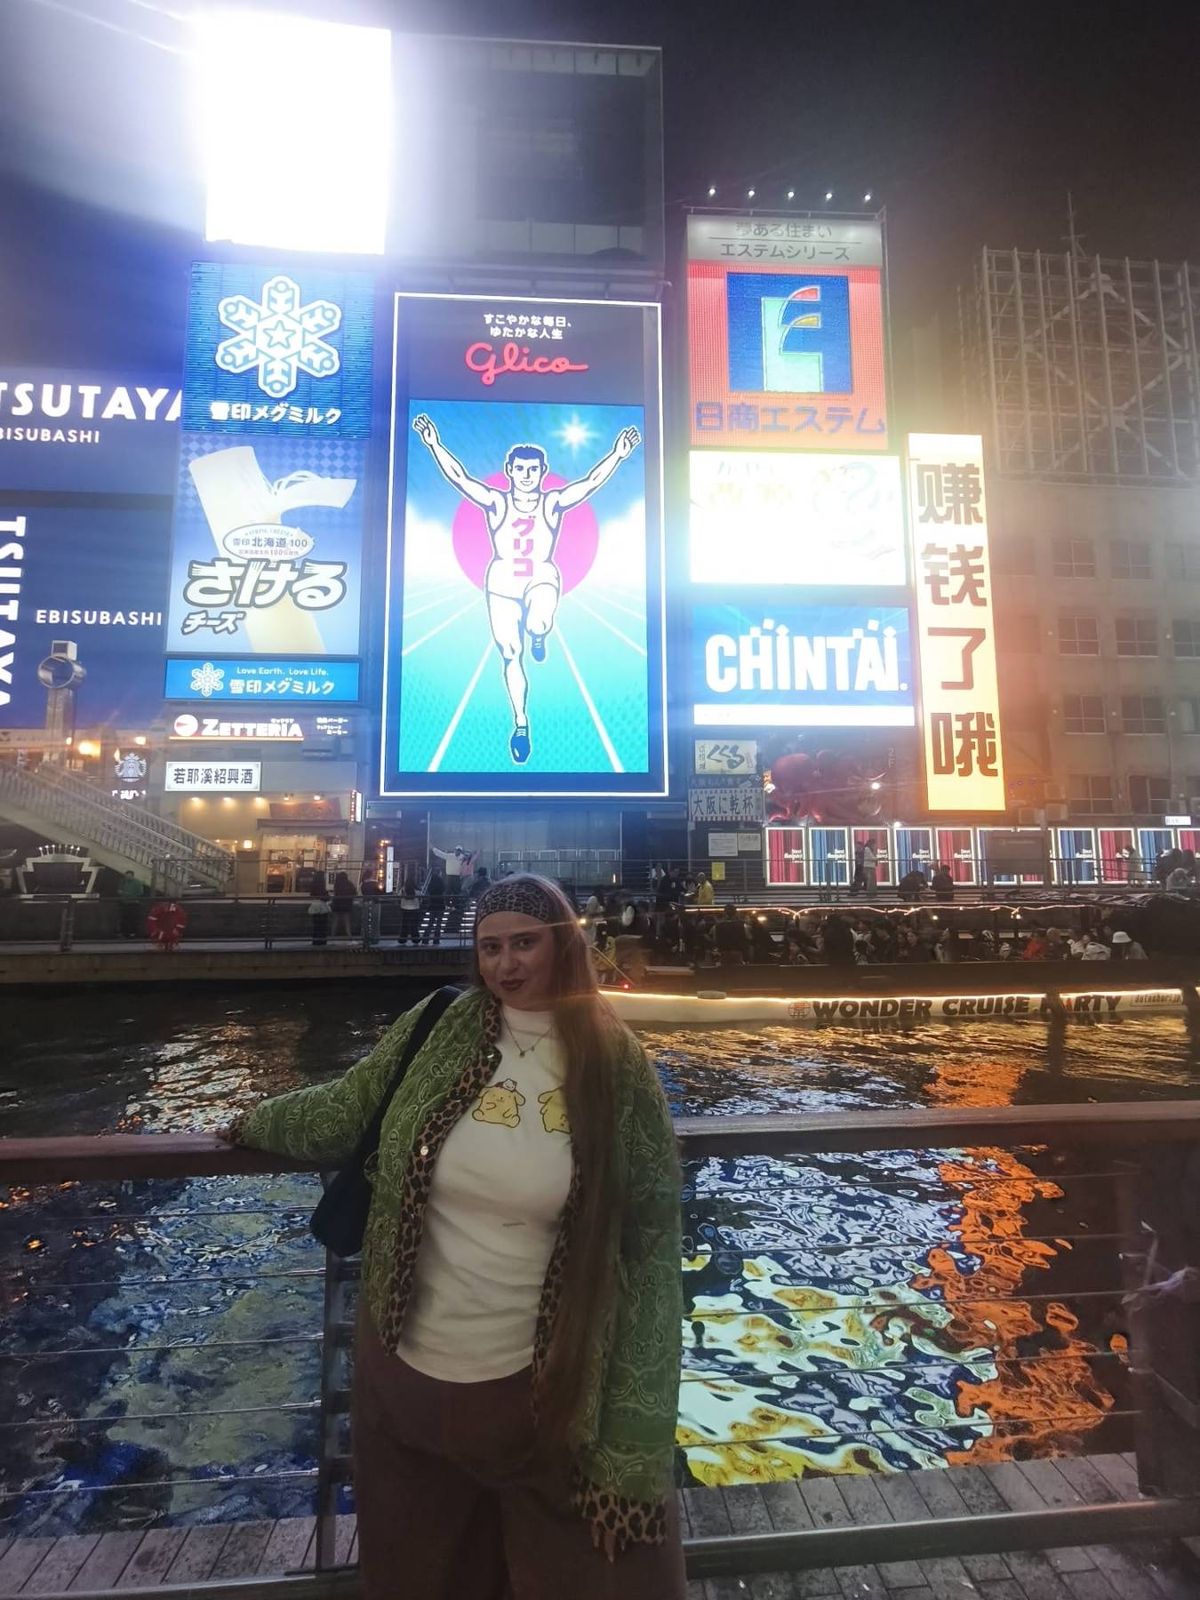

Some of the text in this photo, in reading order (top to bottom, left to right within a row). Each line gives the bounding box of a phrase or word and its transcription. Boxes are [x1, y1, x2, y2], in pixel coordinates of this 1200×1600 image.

[490, 326, 563, 340] ゆたかな人生
[210, 401, 341, 425] 雪印メグミルク
[696, 401, 886, 434] 日商エステム
[511, 515, 536, 577] グリコ
[183, 557, 348, 611] さける
[36, 609, 162, 626] EBISUBASHI
[181, 610, 246, 635] チーズ
[916, 462, 998, 777] 赚钱了哦
[236, 666, 328, 676] Love Earth. Love Life.
[230, 677, 335, 695] 雪印メグミルク
[173, 767, 254, 785] 若耶溪紹興酒
[693, 793, 754, 816] 大阪に乾杯
[812, 999, 933, 1018] WONDER
[942, 996, 1030, 1017] CRUISE
